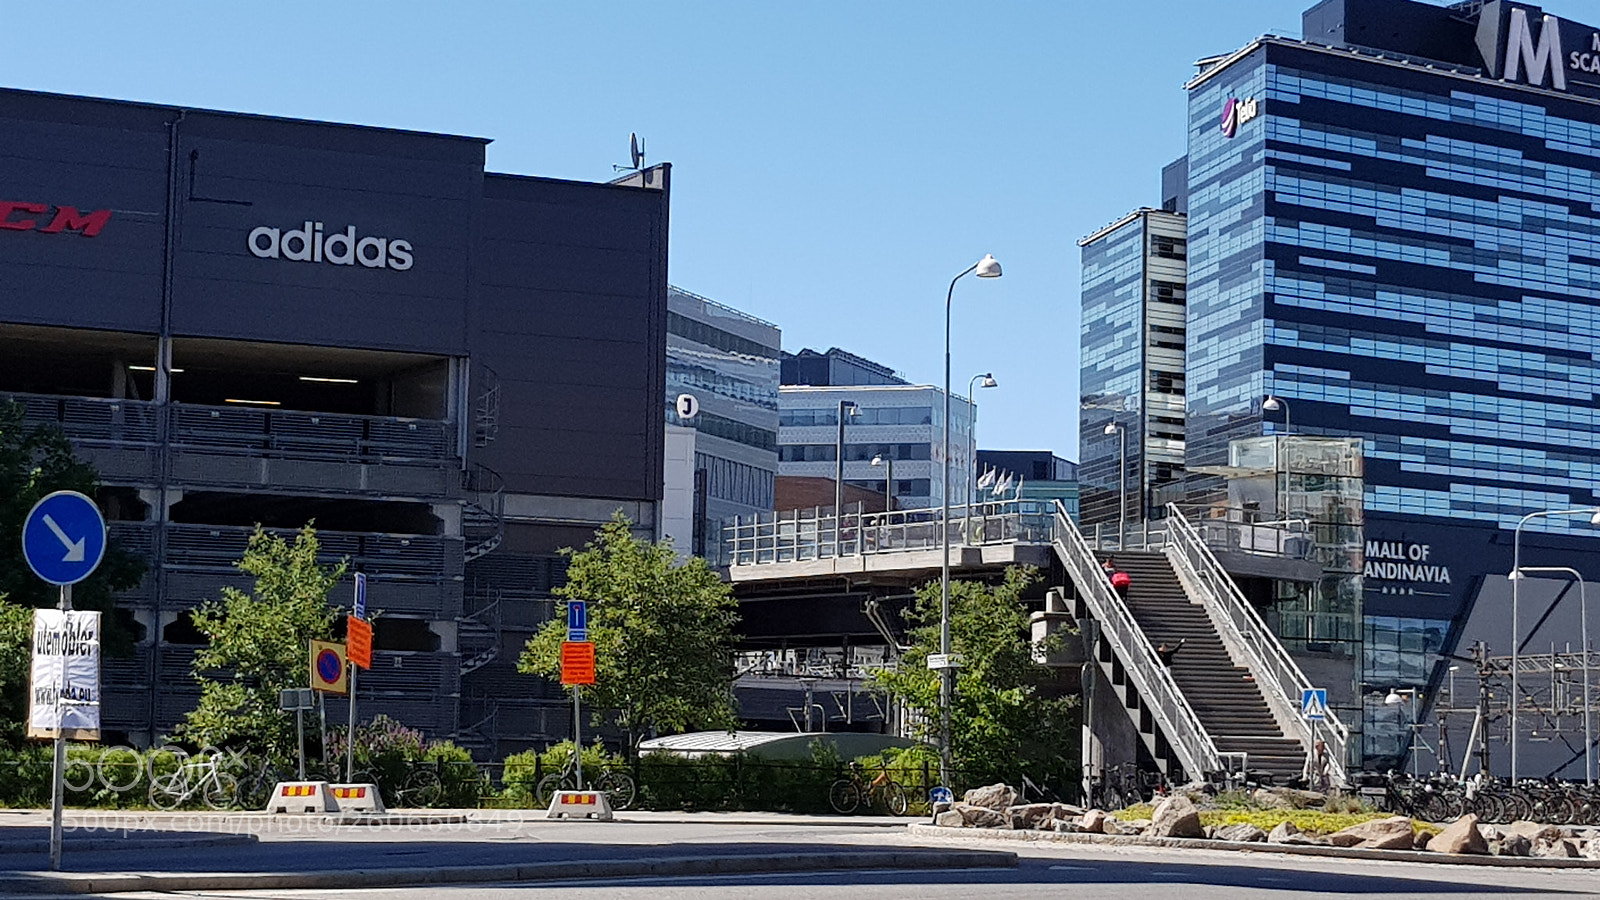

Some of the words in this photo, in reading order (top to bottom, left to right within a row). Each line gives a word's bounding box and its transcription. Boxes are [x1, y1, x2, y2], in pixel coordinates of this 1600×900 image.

[1503, 7, 1567, 91] M
[248, 221, 414, 271] adidas
[682, 397, 692, 416] J
[1365, 540, 1406, 560] MALL
[1408, 543, 1430, 561] OF
[1363, 560, 1451, 584] ANDINAVIA
